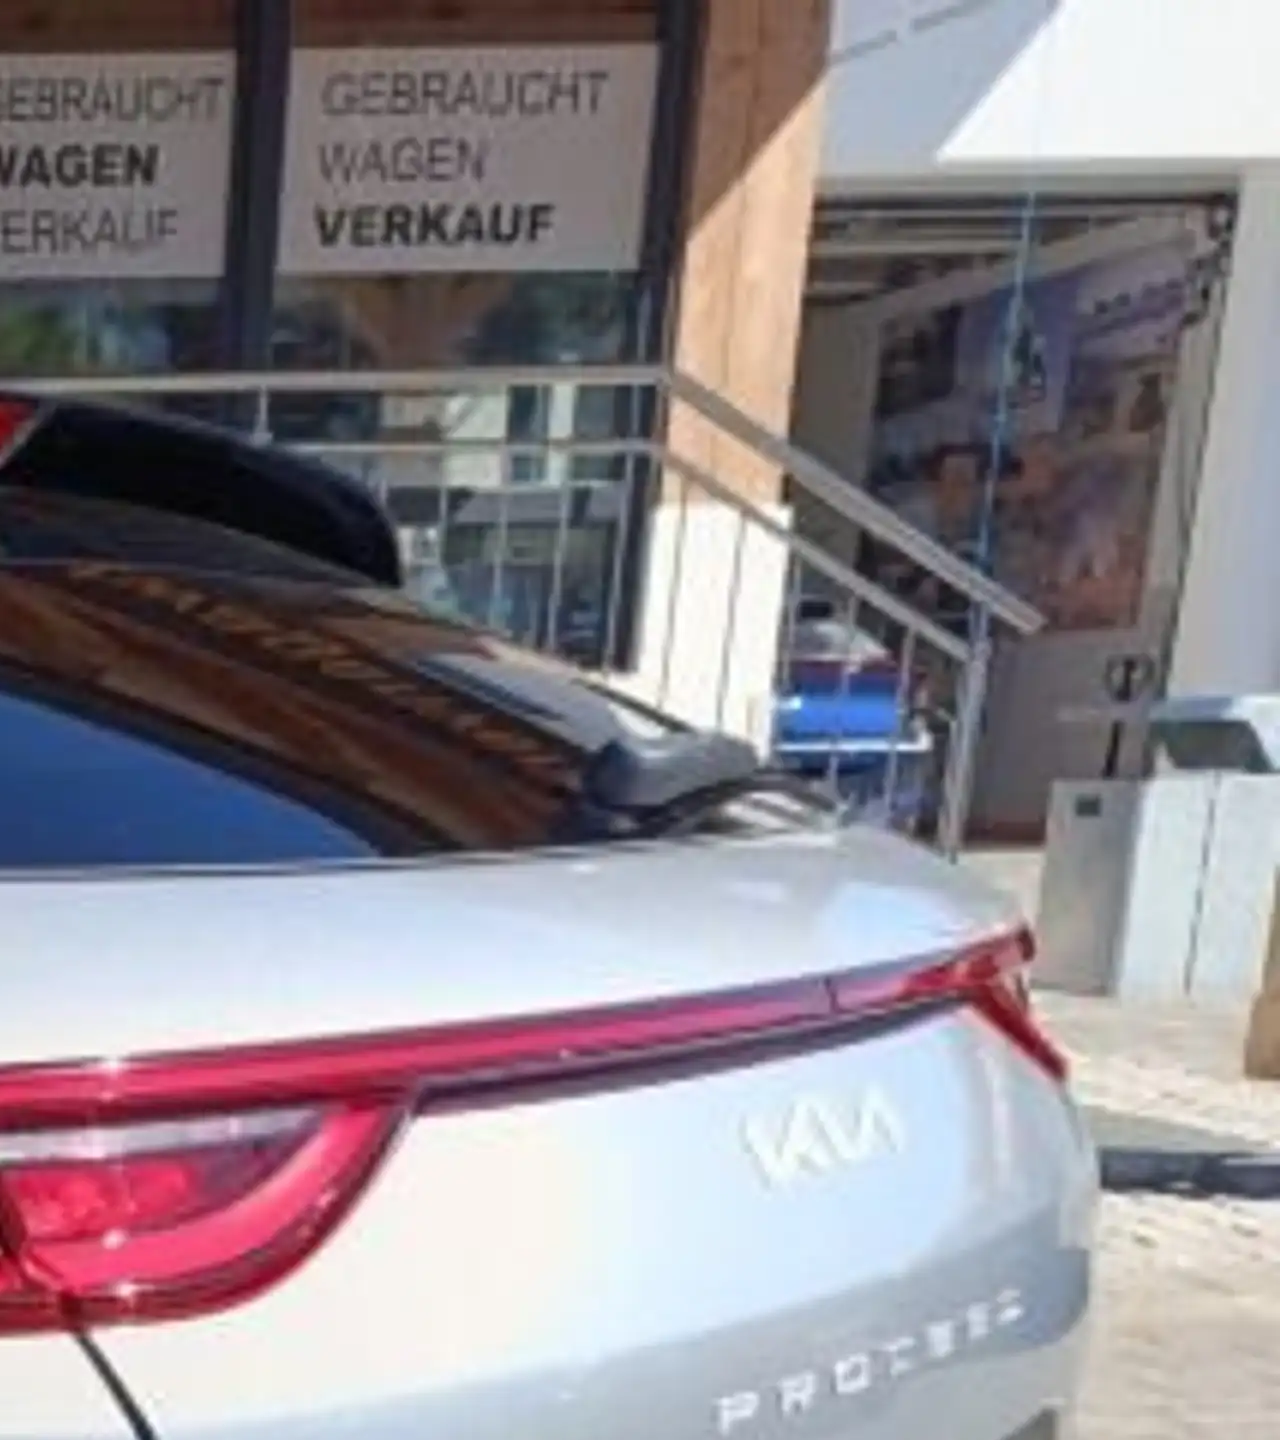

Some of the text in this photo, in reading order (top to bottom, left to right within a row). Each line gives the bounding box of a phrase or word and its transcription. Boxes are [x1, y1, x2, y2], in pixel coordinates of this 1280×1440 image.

[321, 70, 609, 118] GEBRAUCHT
[318, 137, 488, 184] WAGEN
[313, 203, 556, 248] VERKAUF
